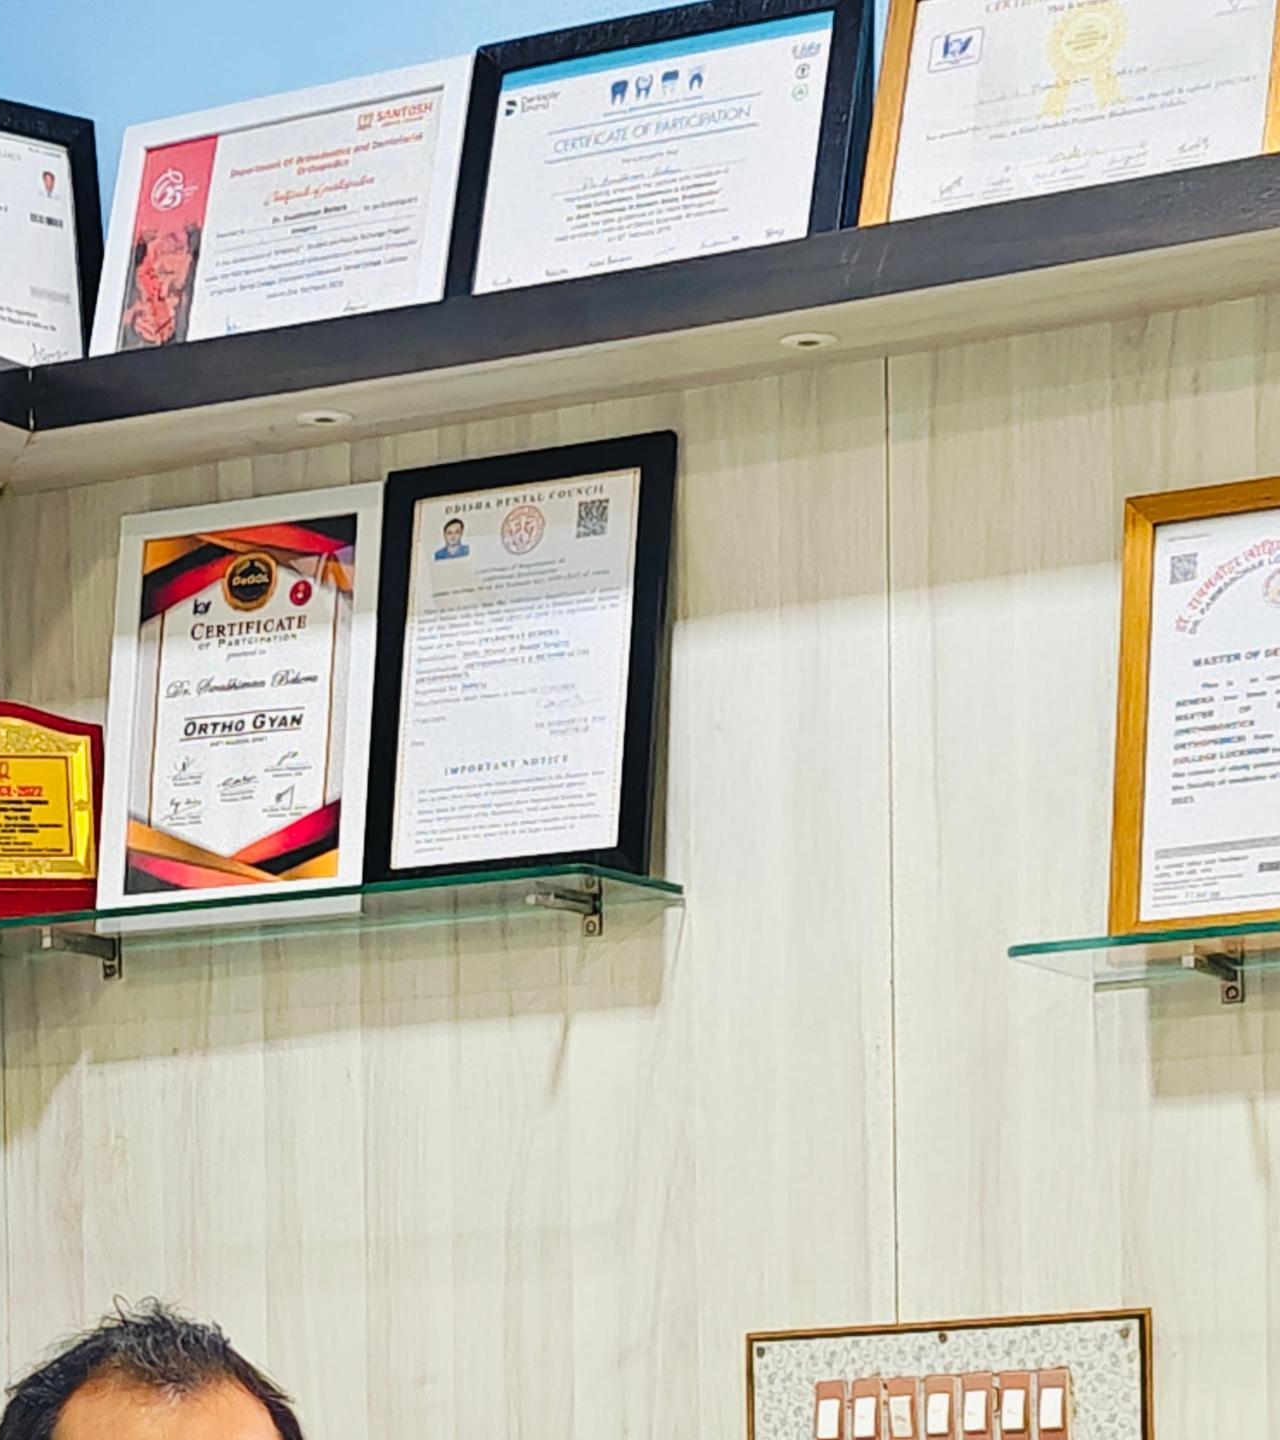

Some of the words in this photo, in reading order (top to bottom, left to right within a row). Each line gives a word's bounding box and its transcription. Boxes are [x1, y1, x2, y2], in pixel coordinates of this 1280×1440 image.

[376, 102, 433, 121] SANTOSH
[553, 128, 629, 154] CERTIFICATE
[632, 123, 649, 139] OF
[654, 104, 752, 136] PARTICIPATION
[445, 501, 491, 515] ODISHA
[496, 493, 545, 508] DENTAL
[549, 484, 604, 500] COUNCIL
[191, 615, 307, 641] CERTIFICATE
[1192, 652, 1241, 668] MASTER
[1244, 651, 1261, 661] OF
[184, 719, 245, 736] ORTHO
[252, 713, 303, 730] GYAN
[444, 759, 516, 776] IMPORTANT
[522, 754, 569, 767] NOTICE
